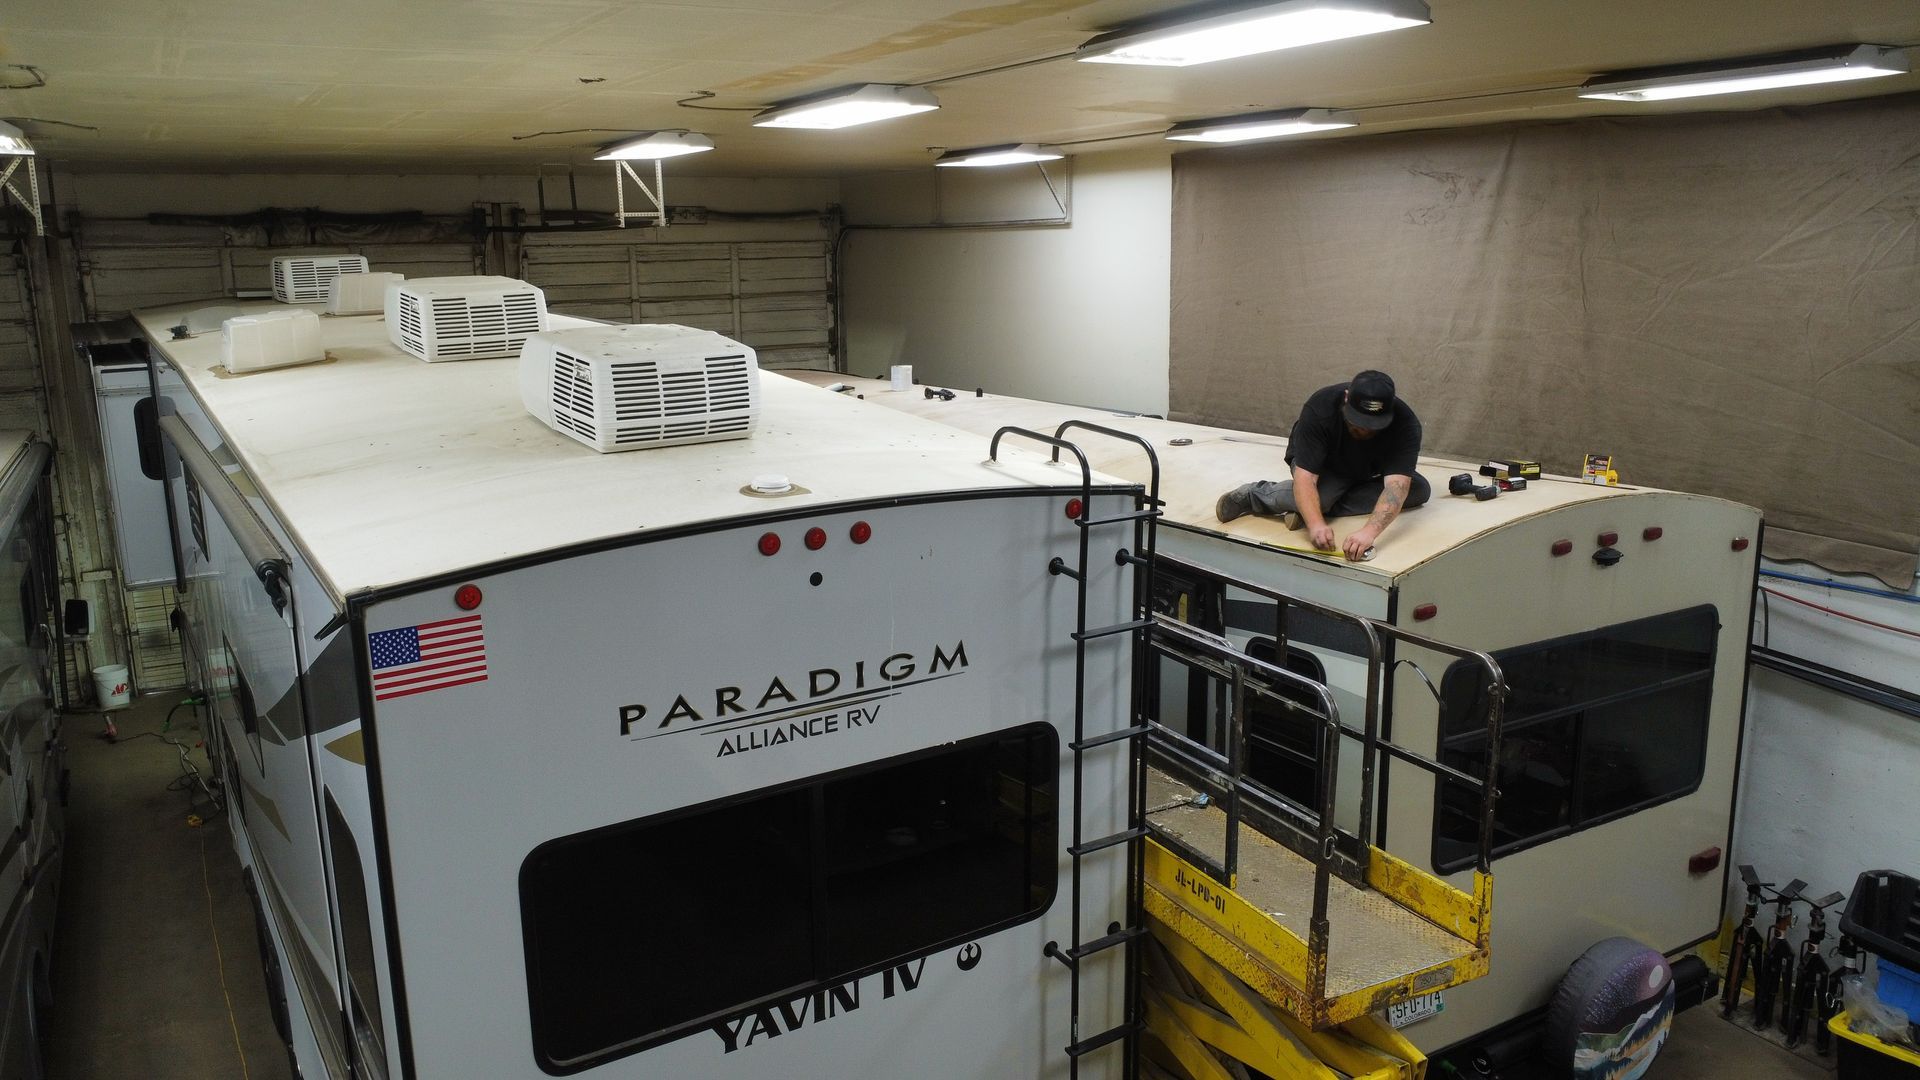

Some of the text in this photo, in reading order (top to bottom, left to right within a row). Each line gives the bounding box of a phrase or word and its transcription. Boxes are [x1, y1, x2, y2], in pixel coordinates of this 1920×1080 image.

[619, 640, 969, 736] PARADIGM
[716, 704, 881, 758] ALLIANCE RV
[711, 957, 928, 1054] YAVIN IV
[1404, 1008, 1432, 1022] COLORADO
